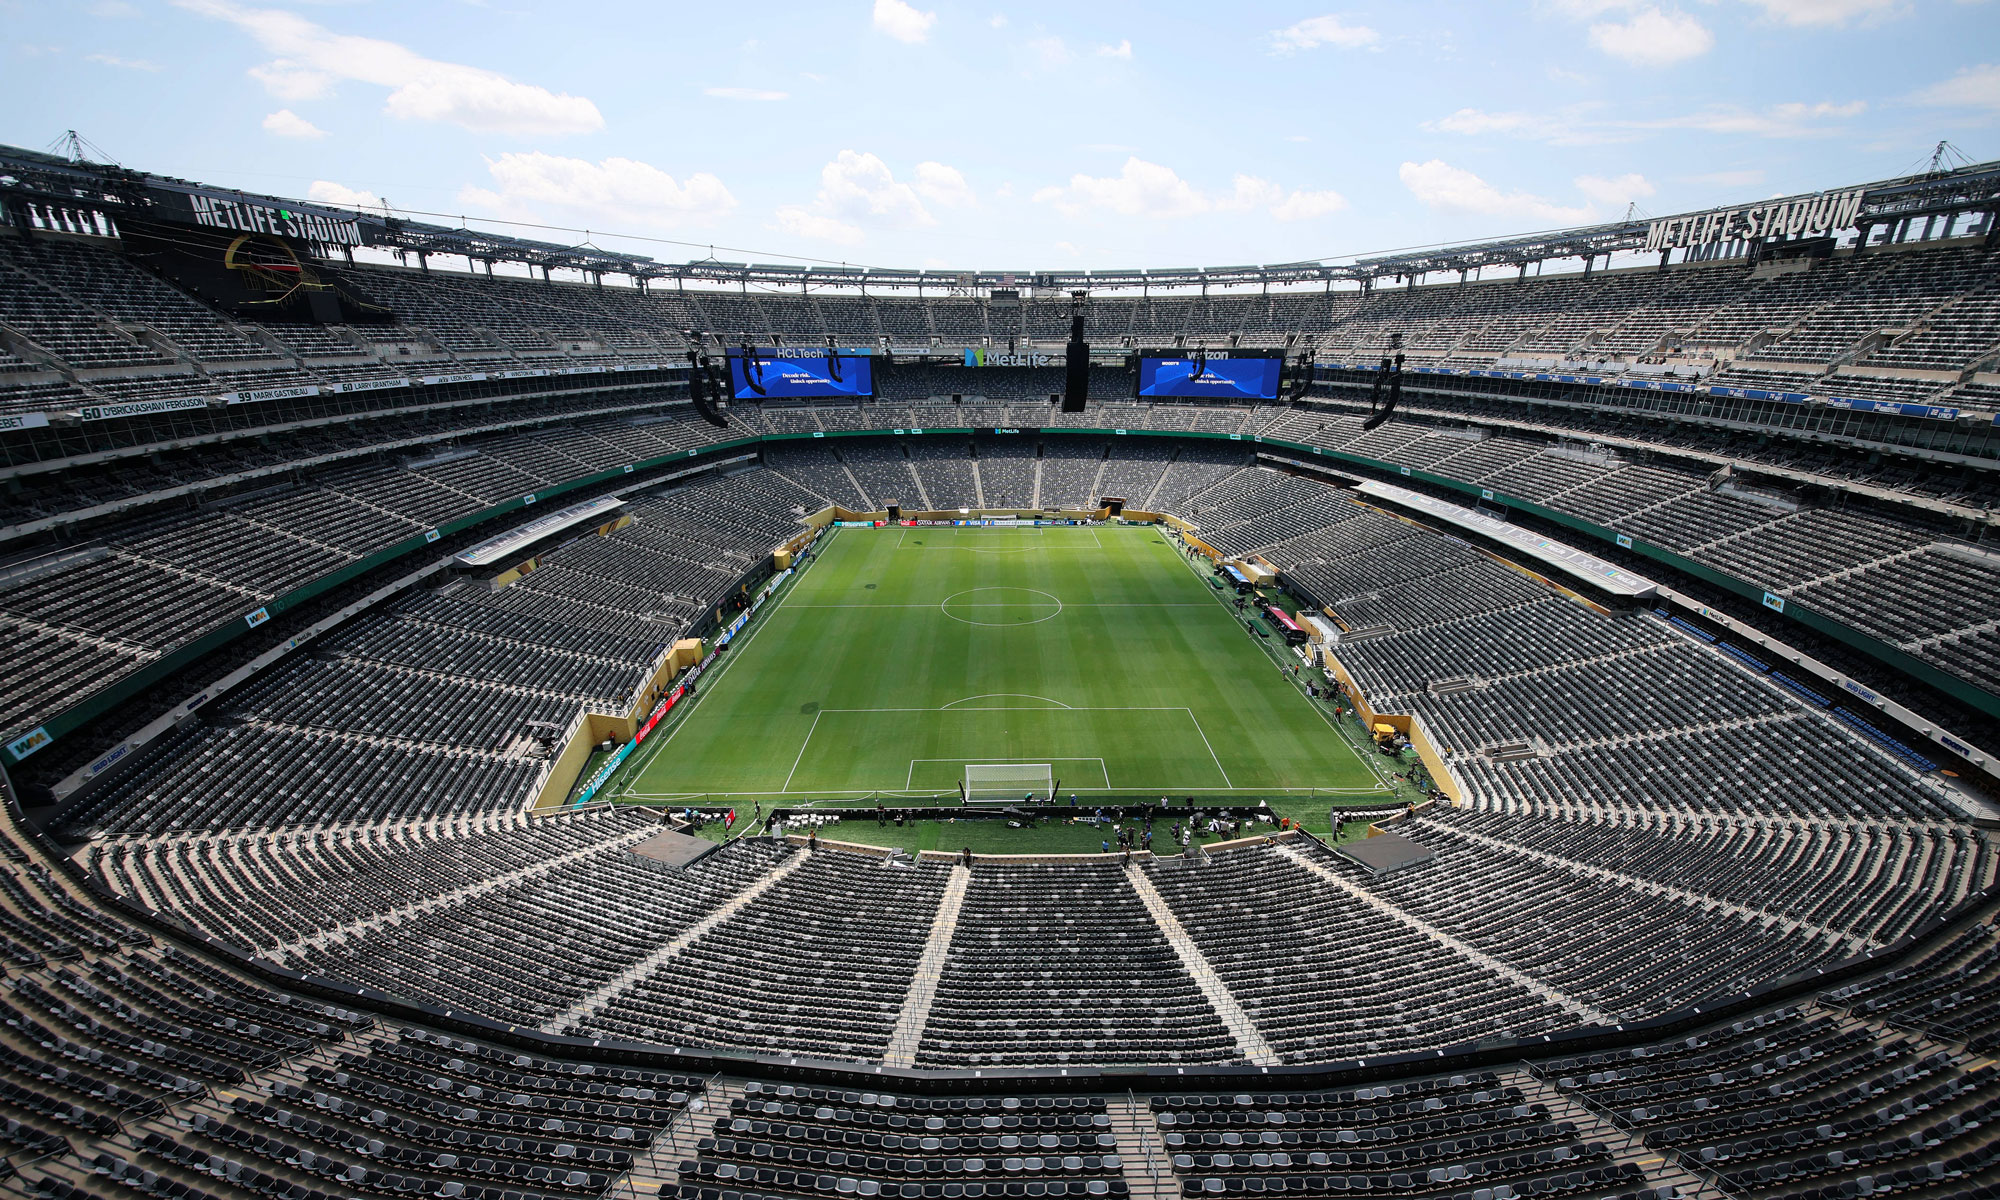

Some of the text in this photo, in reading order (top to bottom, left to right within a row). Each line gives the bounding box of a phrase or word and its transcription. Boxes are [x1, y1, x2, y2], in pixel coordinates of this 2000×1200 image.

[188, 194, 364, 246] METLIFE STADIUM
[1644, 189, 1865, 251] METLIFE STADIUM
[776, 348, 824, 359] HCLTech
[986, 351, 1049, 367] MetLife
[238, 388, 308, 402] 99 MARK GASTINEAU
[342, 380, 402, 392] 60 LARRY GRANTHAM
[82, 398, 205, 420] 60 D'BRICKASHAW FERGUSON
[1766, 596, 1782, 608] WM
[248, 610, 266, 624] WM
[1709, 611, 1724, 622] MetLife
[1846, 682, 1876, 703] BUD LIGHT
[14, 732, 47, 754] WM
[92, 746, 128, 773] BUD LIGHT
[591, 757, 622, 795] Hisense
